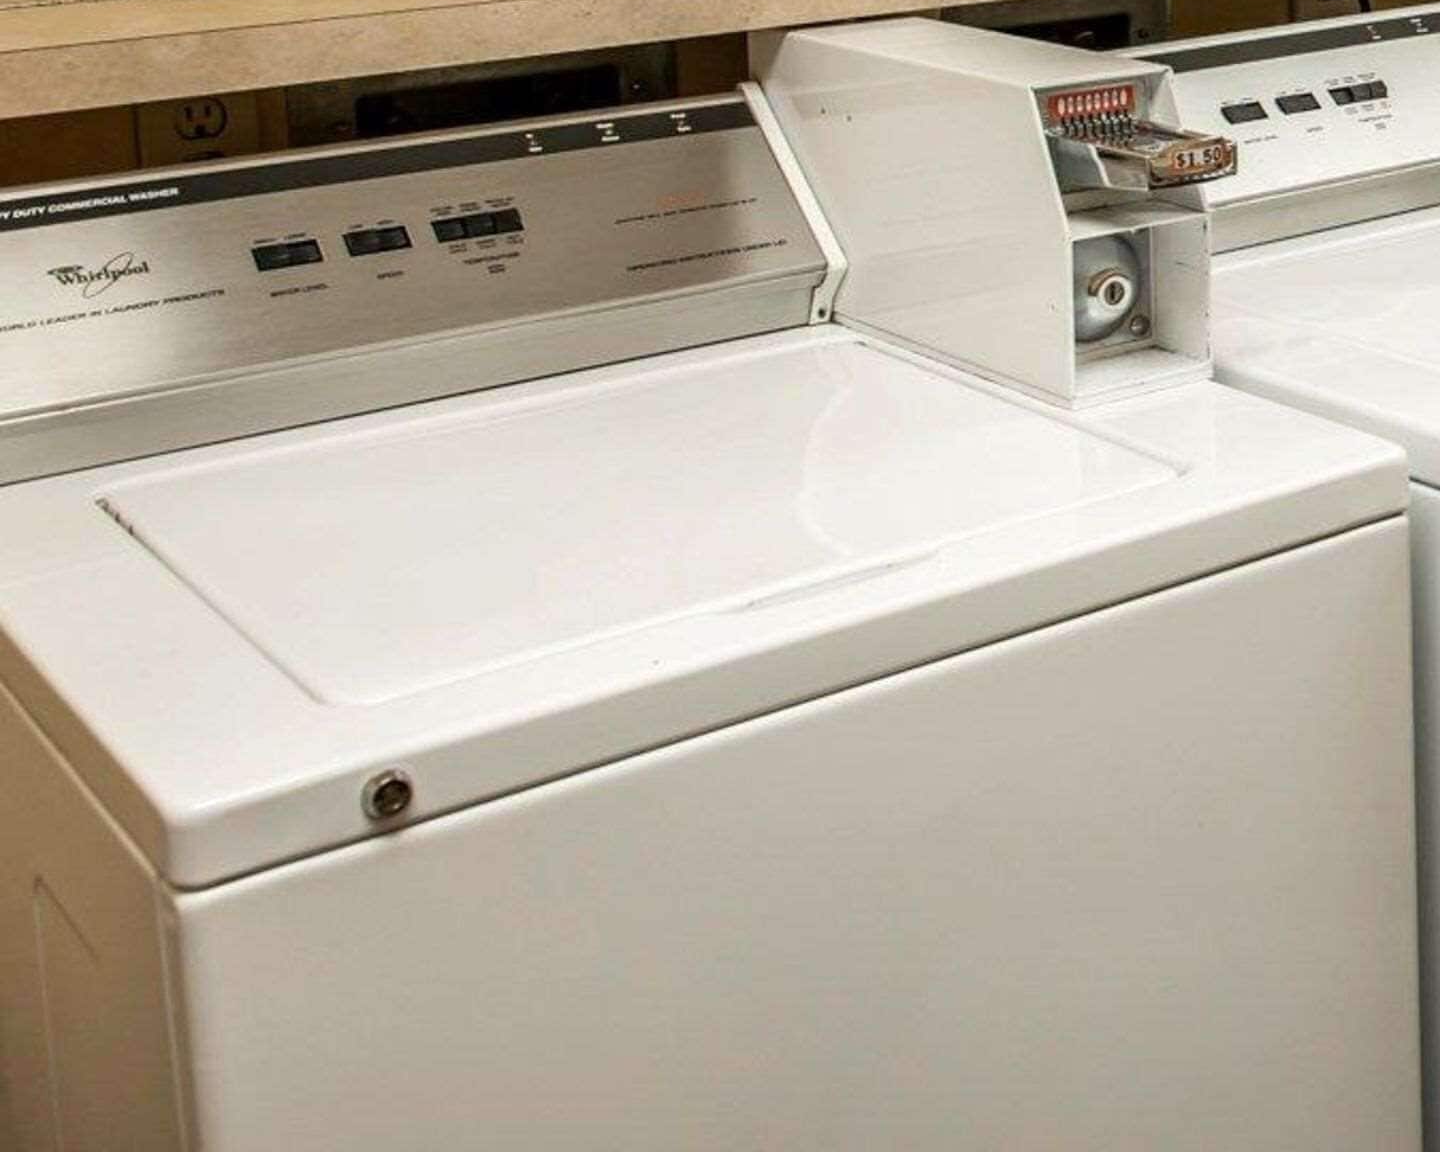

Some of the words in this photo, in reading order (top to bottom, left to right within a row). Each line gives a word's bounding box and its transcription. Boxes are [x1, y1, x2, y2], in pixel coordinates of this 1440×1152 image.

[13, 206, 46, 218] DUTY
[49, 196, 127, 213] COMMERCIAL
[128, 187, 178, 202] WASHER
[51, 256, 150, 291] Whirlpool
